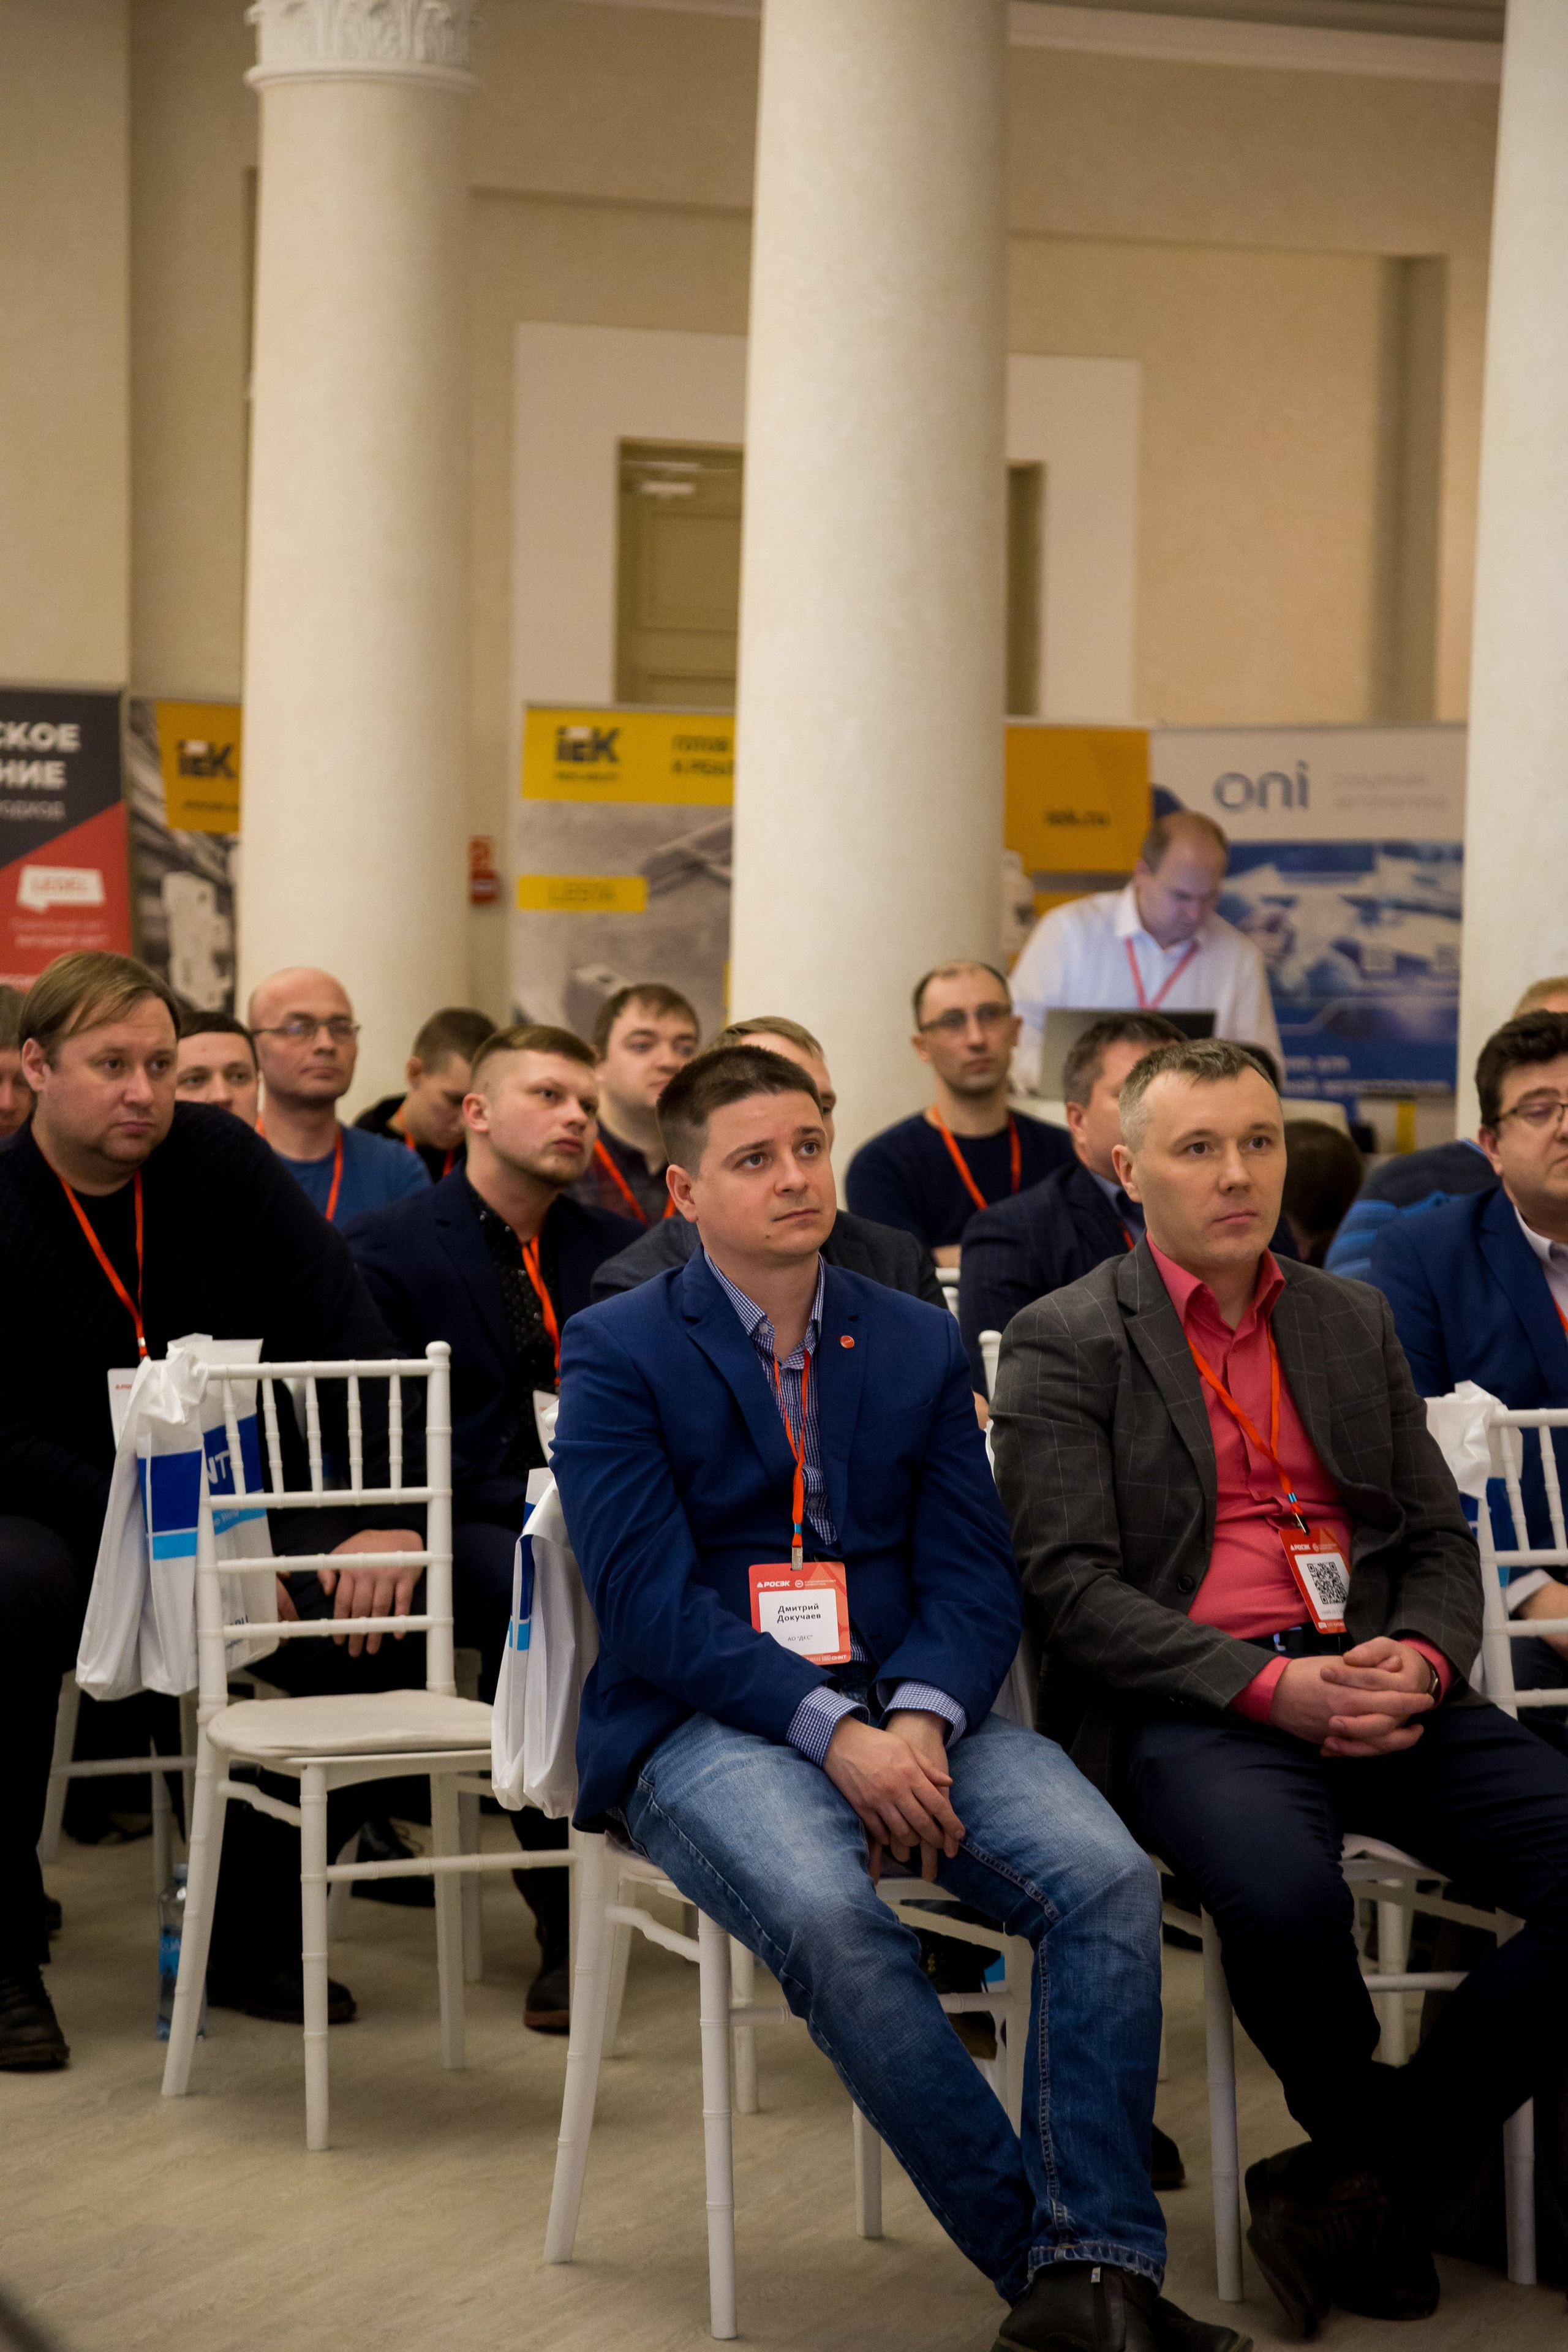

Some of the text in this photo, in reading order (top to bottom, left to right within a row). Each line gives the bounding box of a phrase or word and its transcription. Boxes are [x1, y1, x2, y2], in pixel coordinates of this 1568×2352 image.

[0, 722, 81, 753] КОЕ
[1213, 760, 1308, 812] oni
[777, 1613, 821, 1624] Докучаев
[778, 1603, 819, 1614] Дмитрий
